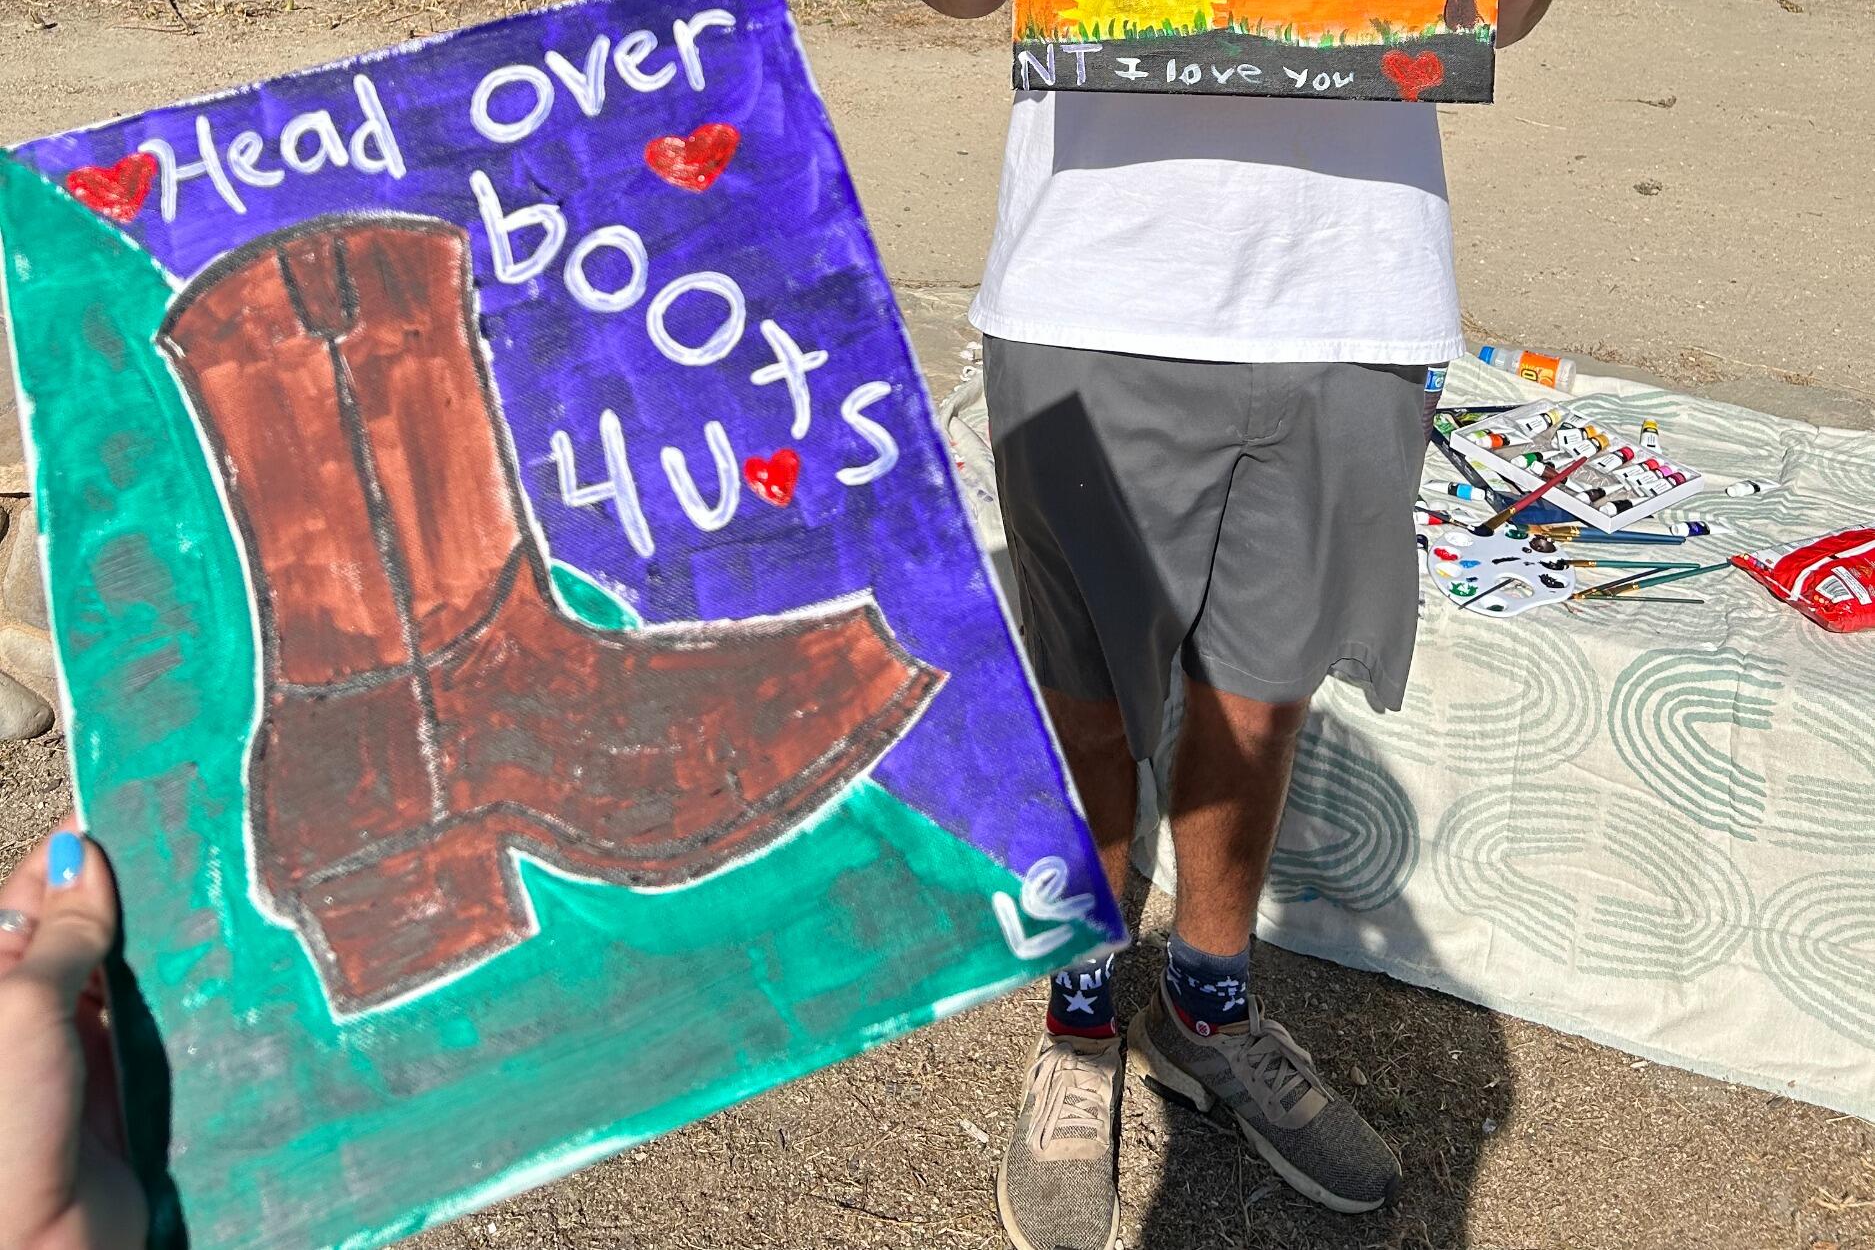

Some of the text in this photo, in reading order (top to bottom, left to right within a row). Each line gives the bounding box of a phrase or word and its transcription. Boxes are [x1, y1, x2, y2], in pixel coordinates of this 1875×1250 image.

[138, 9, 737, 222] Head over
[1114, 58, 1149, 81] I
[1166, 58, 1262, 85] love
